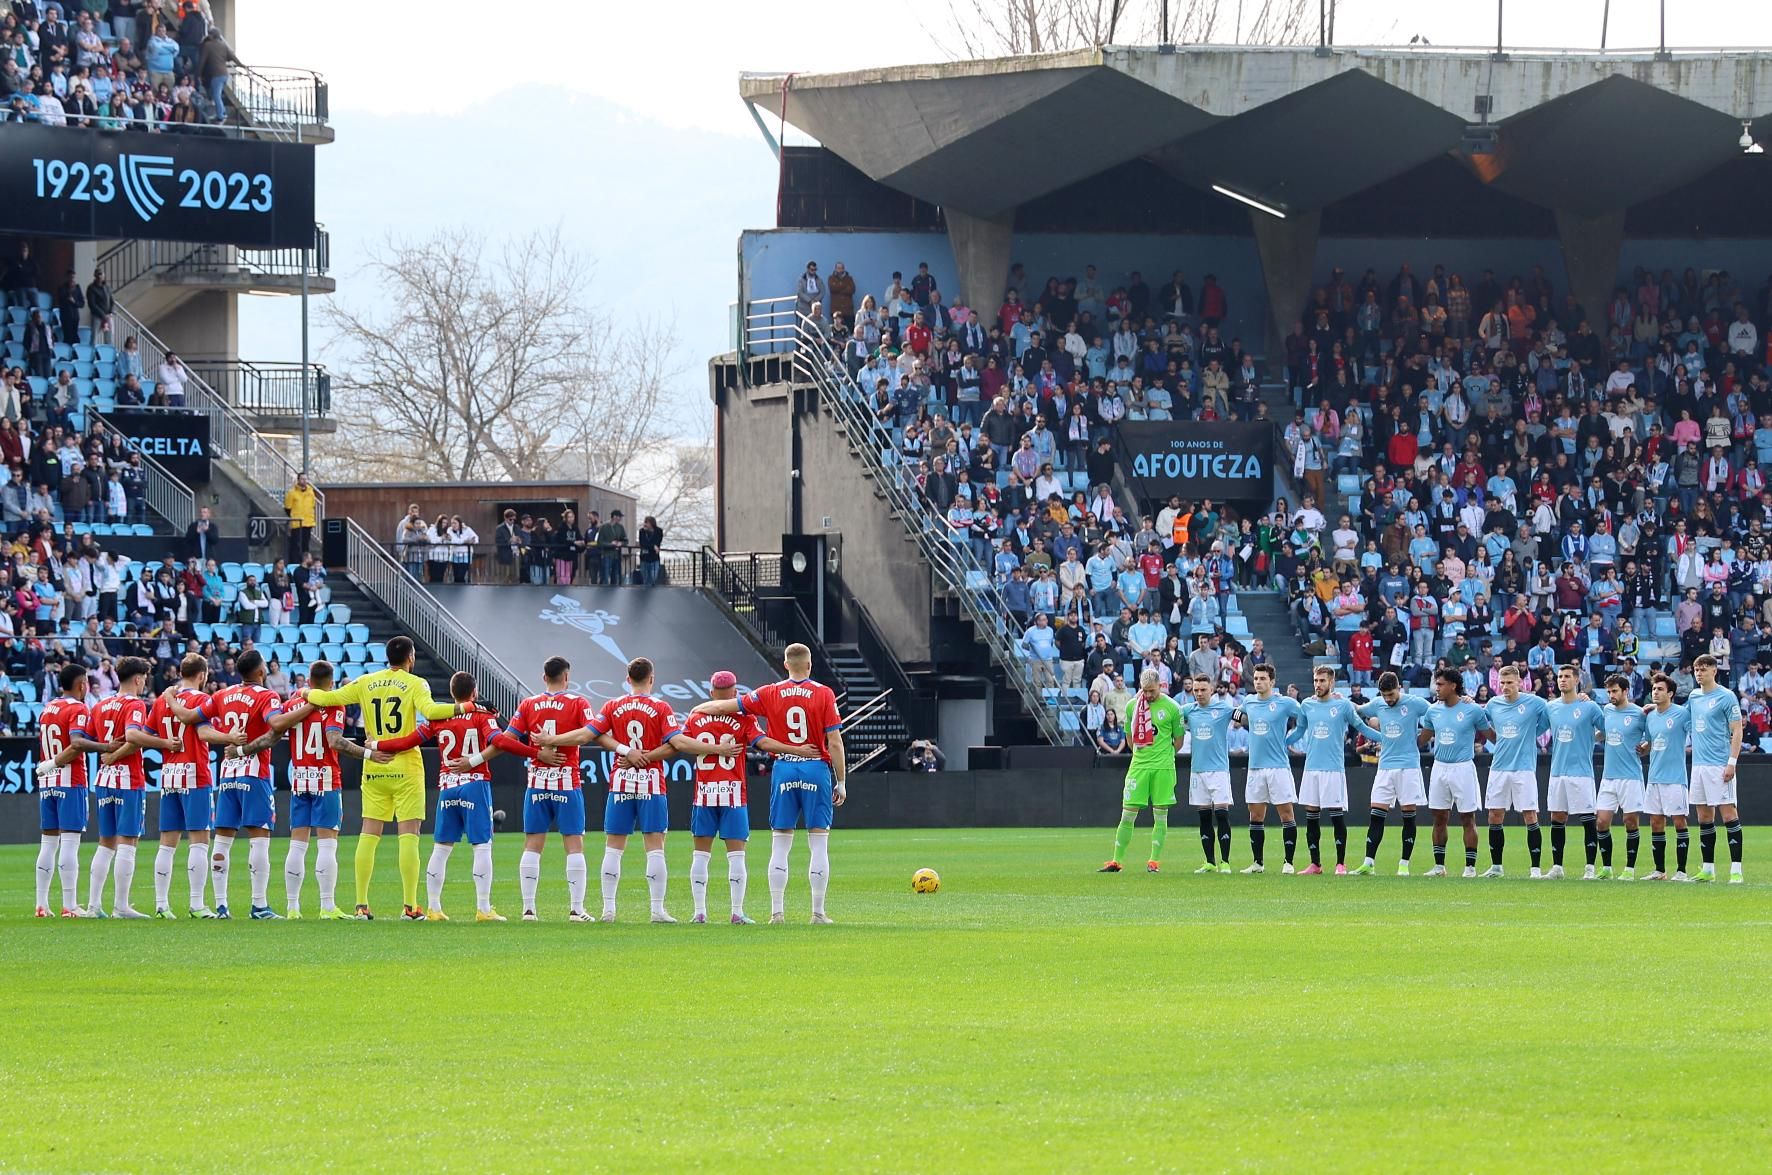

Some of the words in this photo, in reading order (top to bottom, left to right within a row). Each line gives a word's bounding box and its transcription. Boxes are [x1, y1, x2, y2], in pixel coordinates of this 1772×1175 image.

[32, 158, 116, 203] 1923
[178, 168, 273, 213] 2023
[1170, 440, 1185, 449] 100
[1186, 440, 1211, 449] ANOS
[1213, 440, 1224, 449] DE
[1132, 452, 1262, 479] AFOUTEZA
[251, 519, 267, 539] 20
[223, 692, 255, 708] HERRERA
[534, 700, 565, 712] ARNAU
[780, 687, 813, 699] DOVBYK
[371, 696, 402, 736] 13
[613, 702, 658, 719] TSYGANKOV
[713, 715, 741, 731] COUTO
[162, 716, 186, 753] 17
[224, 711, 249, 737] 21
[626, 720, 644, 751] 8
[786, 706, 809, 744] 9
[40, 723, 63, 761] 16
[292, 721, 325, 761] 14
[438, 727, 481, 767] 24
[696, 731, 737, 770] 20
[162, 766, 185, 775] arlex
[618, 770, 650, 781] Marlex
[699, 784, 731, 794] Marlex
